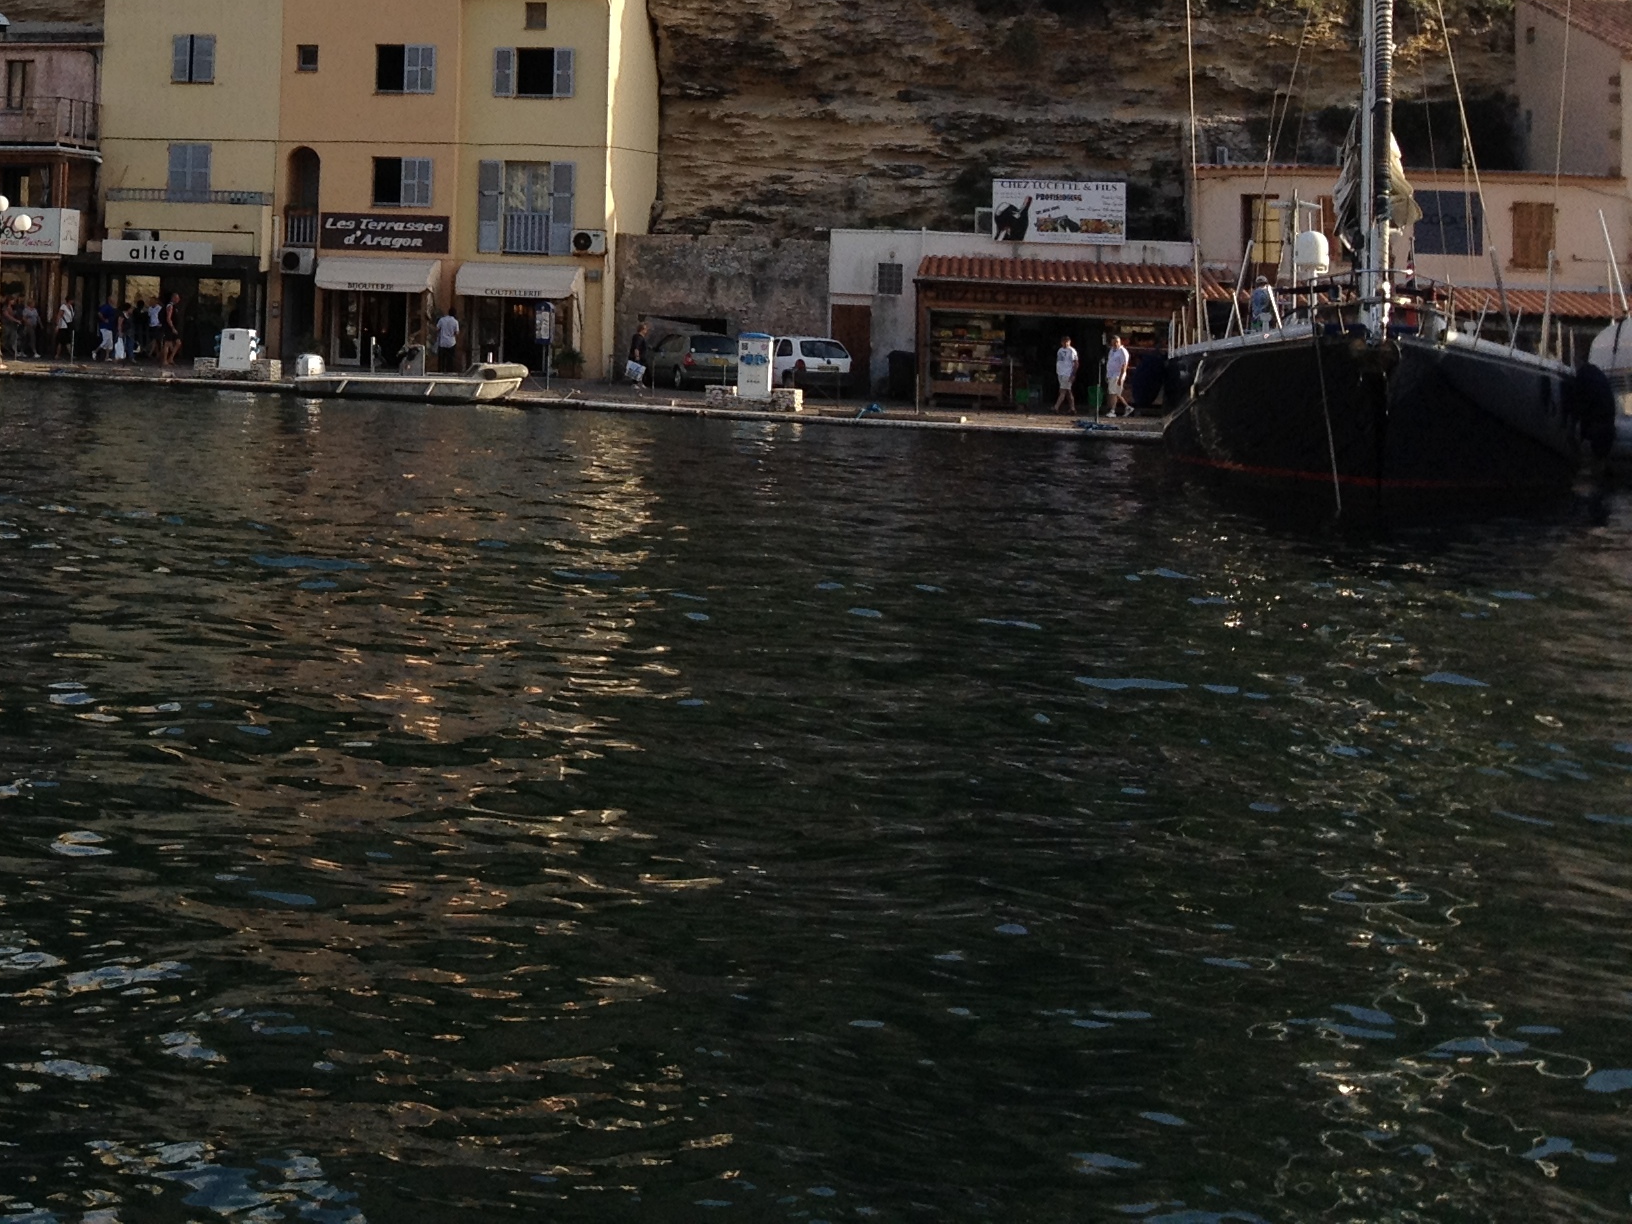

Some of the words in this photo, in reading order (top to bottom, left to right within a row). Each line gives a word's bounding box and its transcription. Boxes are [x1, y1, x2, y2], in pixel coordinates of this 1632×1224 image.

[1000, 181, 1029, 189] CHEZ
[1031, 181, 1080, 191] LUCETTE
[1082, 183, 1092, 191] &
[1095, 183, 1118, 192] FILS
[325, 217, 356, 230] Les
[359, 218, 444, 232] Terrasses
[343, 230, 423, 249] d'Aragon
[129, 244, 185, 261] altéa
[347, 282, 394, 291] BIJOUTERIE
[484, 288, 542, 297] COUTELLERIE
